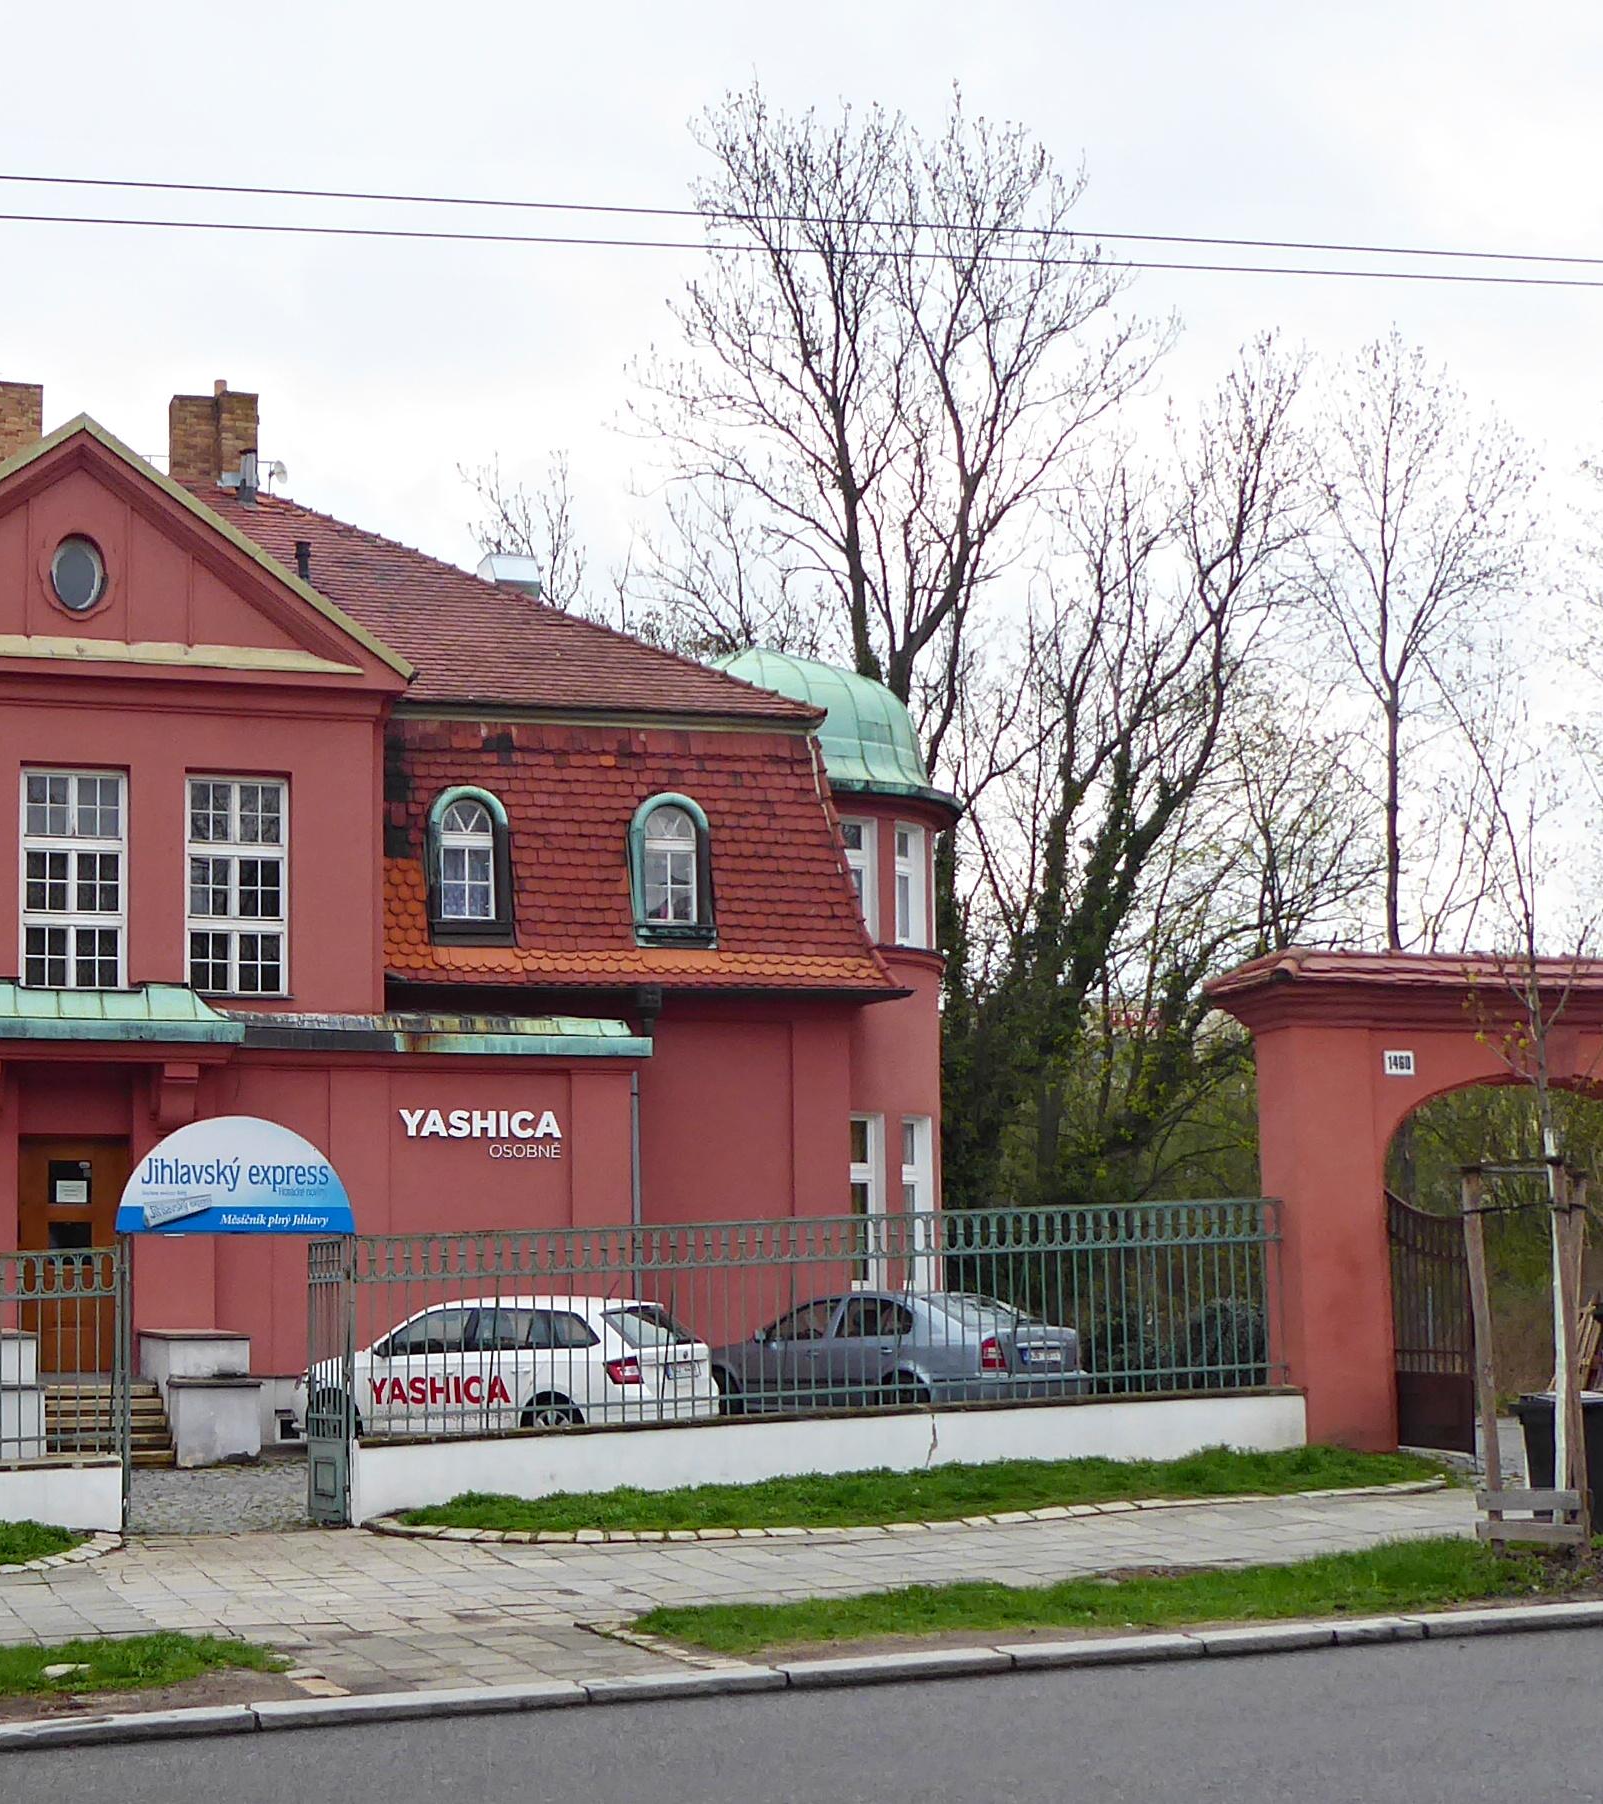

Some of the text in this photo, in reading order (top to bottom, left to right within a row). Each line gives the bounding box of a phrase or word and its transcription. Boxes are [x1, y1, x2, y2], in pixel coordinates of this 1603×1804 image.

[399, 1109, 562, 1138] YASHICA
[489, 1142, 562, 1159] OSOBNĚ
[141, 1156, 329, 1192] Jihlavský express
[267, 1213, 290, 1227] plný
[368, 1375, 511, 1405] YASHICA
